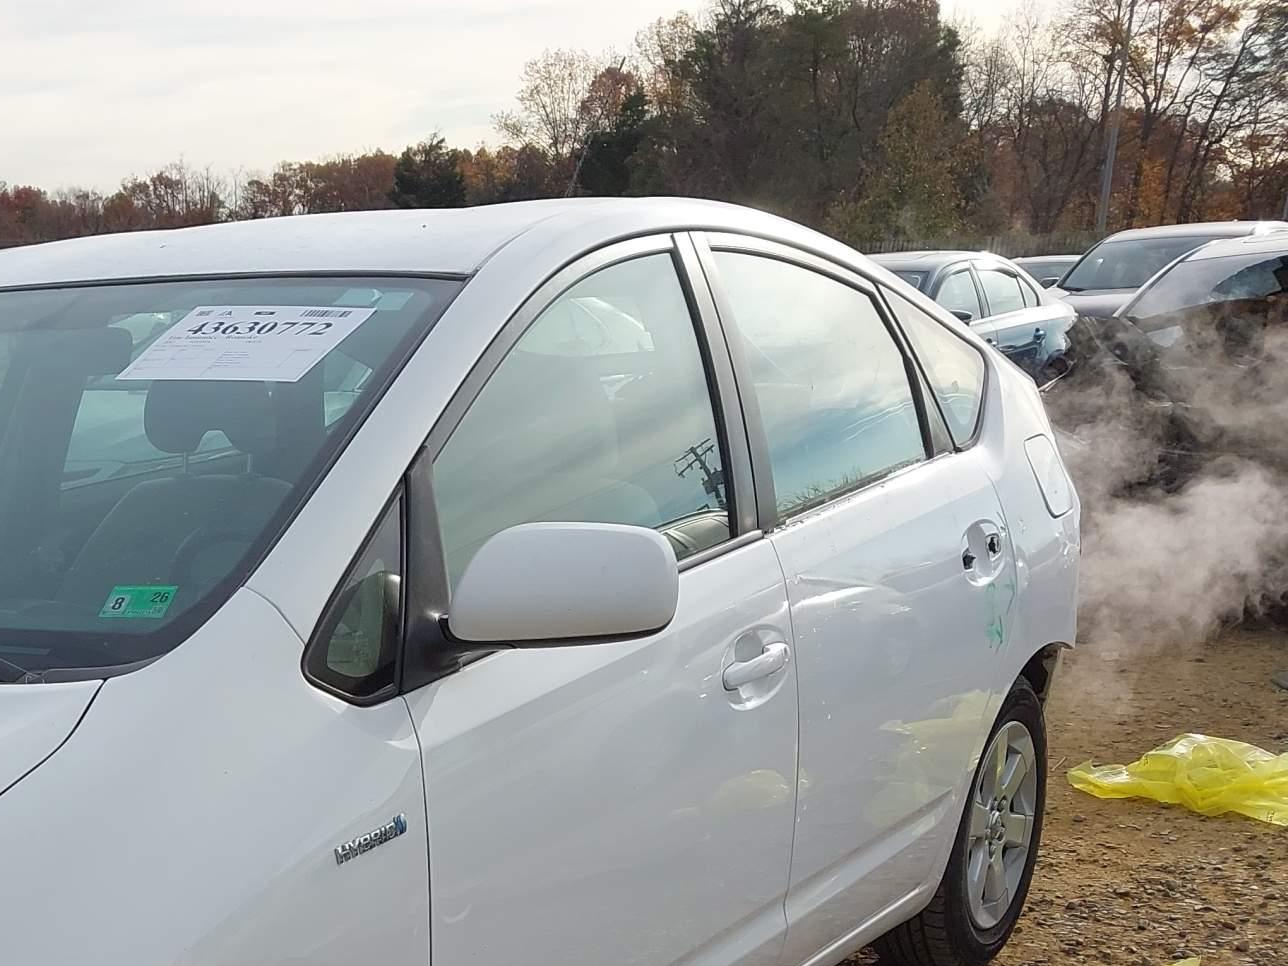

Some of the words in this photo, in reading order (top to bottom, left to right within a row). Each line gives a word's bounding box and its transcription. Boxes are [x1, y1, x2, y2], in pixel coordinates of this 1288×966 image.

[187, 321, 333, 335] 43630772
[112, 596, 125, 610] 8
[334, 821, 399, 865] HYBRID
